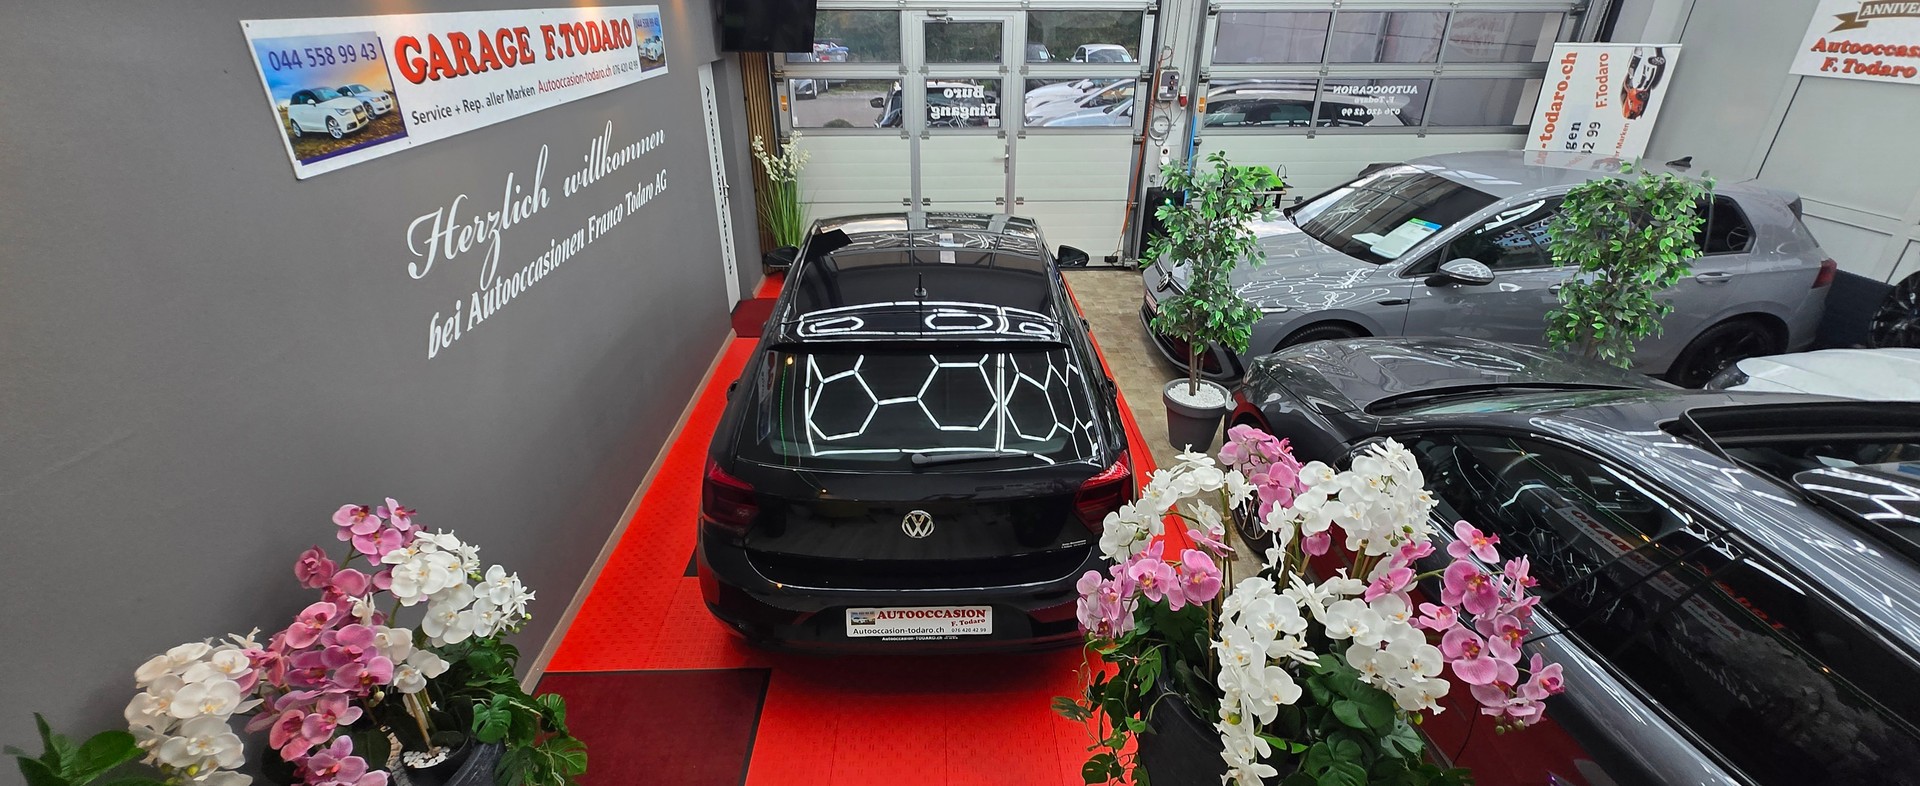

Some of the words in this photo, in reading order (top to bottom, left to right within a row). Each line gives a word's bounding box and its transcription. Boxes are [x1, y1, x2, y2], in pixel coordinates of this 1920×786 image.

[1861, 2, 1920, 16] ANNIVE
[268, 50, 303, 71] 044
[304, 46, 336, 68] 558
[337, 44, 357, 64] 99
[360, 42, 378, 61] 43
[394, 26, 536, 85] GARAGE
[540, 18, 633, 61] F.TODARO
[1595, 52, 1609, 109] F.Todaro
[1820, 57, 1838, 73] F.
[1842, 58, 1918, 79] Todaro
[411, 104, 453, 126] Service
[462, 99, 484, 114] Rep.
[486, 92, 505, 107] aller
[506, 85, 536, 102] Marken
[538, 65, 612, 94] Autooccasion-todaro.ch
[1539, 52, 1578, 149] -todaro.ch
[1587, 121, 1601, 138] 99
[1616, 123, 1630, 149] Marken
[406, 143, 550, 291] Herzlich
[562, 119, 665, 198] willkommen
[428, 300, 461, 360] bei
[466, 226, 586, 332] Autooccasionen
[588, 203, 624, 245] Franco
[624, 182, 654, 217] Todaro
[654, 168, 667, 196] AG
[877, 609, 987, 620] AUTOOCCASION
[959, 618, 986, 626] Todaro
[853, 627, 945, 635] Autooccasion-todaro.ch
